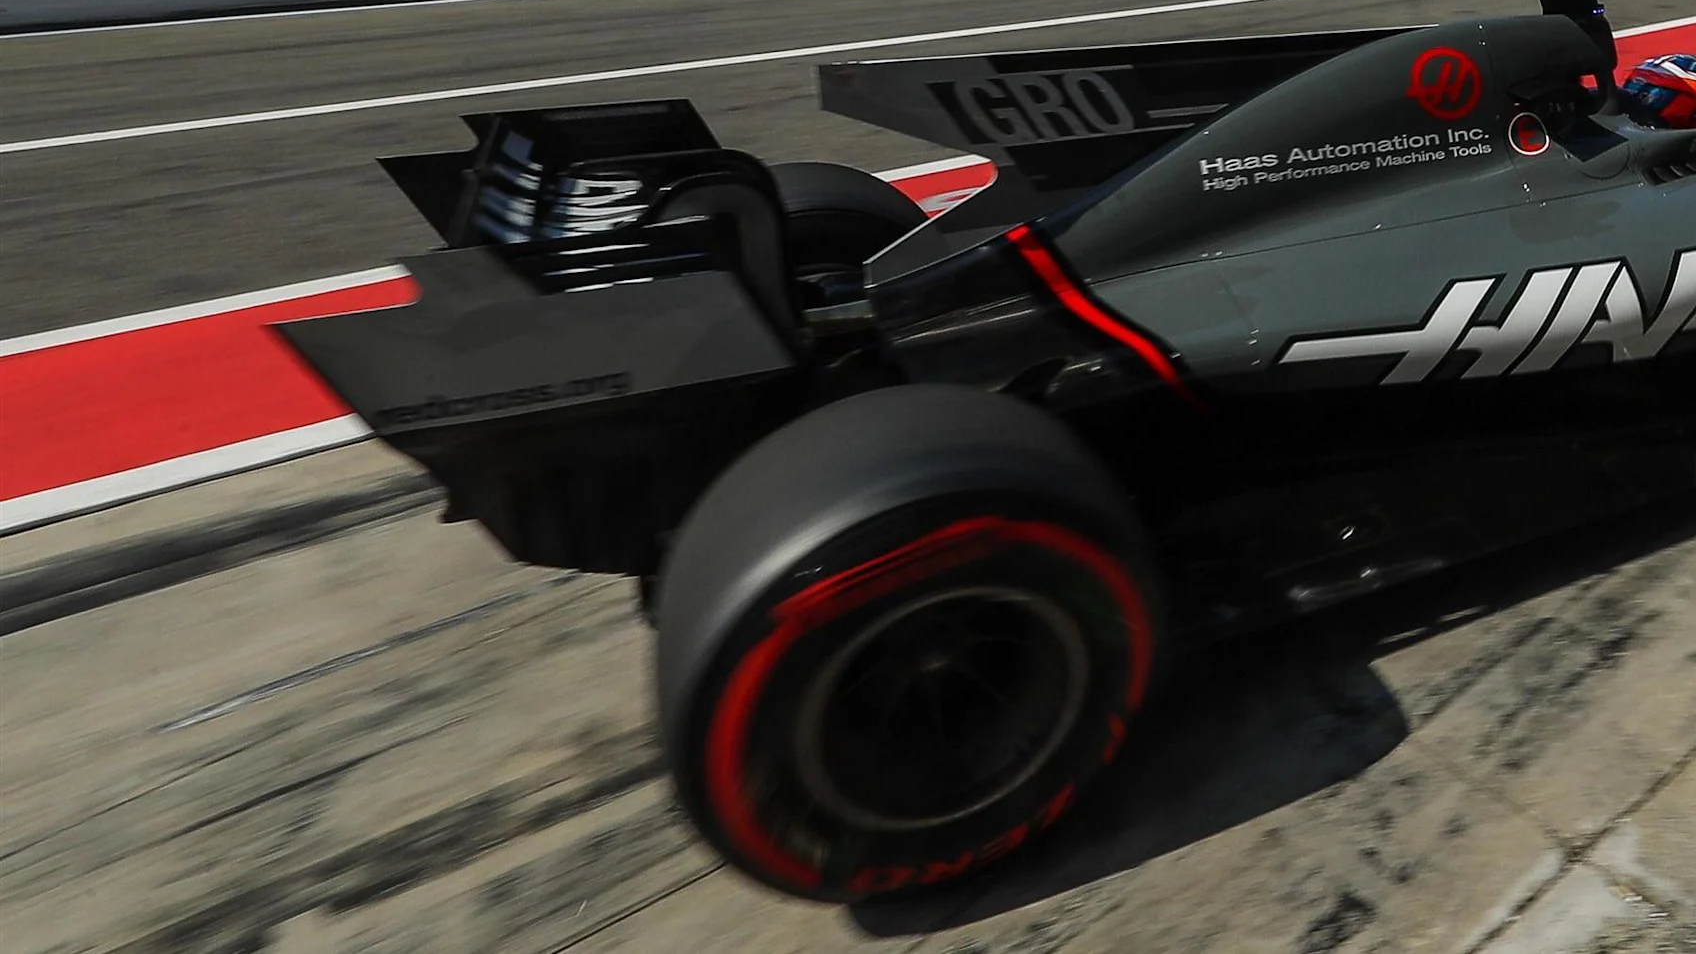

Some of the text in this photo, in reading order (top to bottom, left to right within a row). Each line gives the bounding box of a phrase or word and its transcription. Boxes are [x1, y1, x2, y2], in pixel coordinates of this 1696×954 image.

[953, 70, 1135, 146] GRO
[1199, 127, 1490, 175] Haas Automation Inc.
[1202, 141, 1492, 191] High Performance Machine Tools
